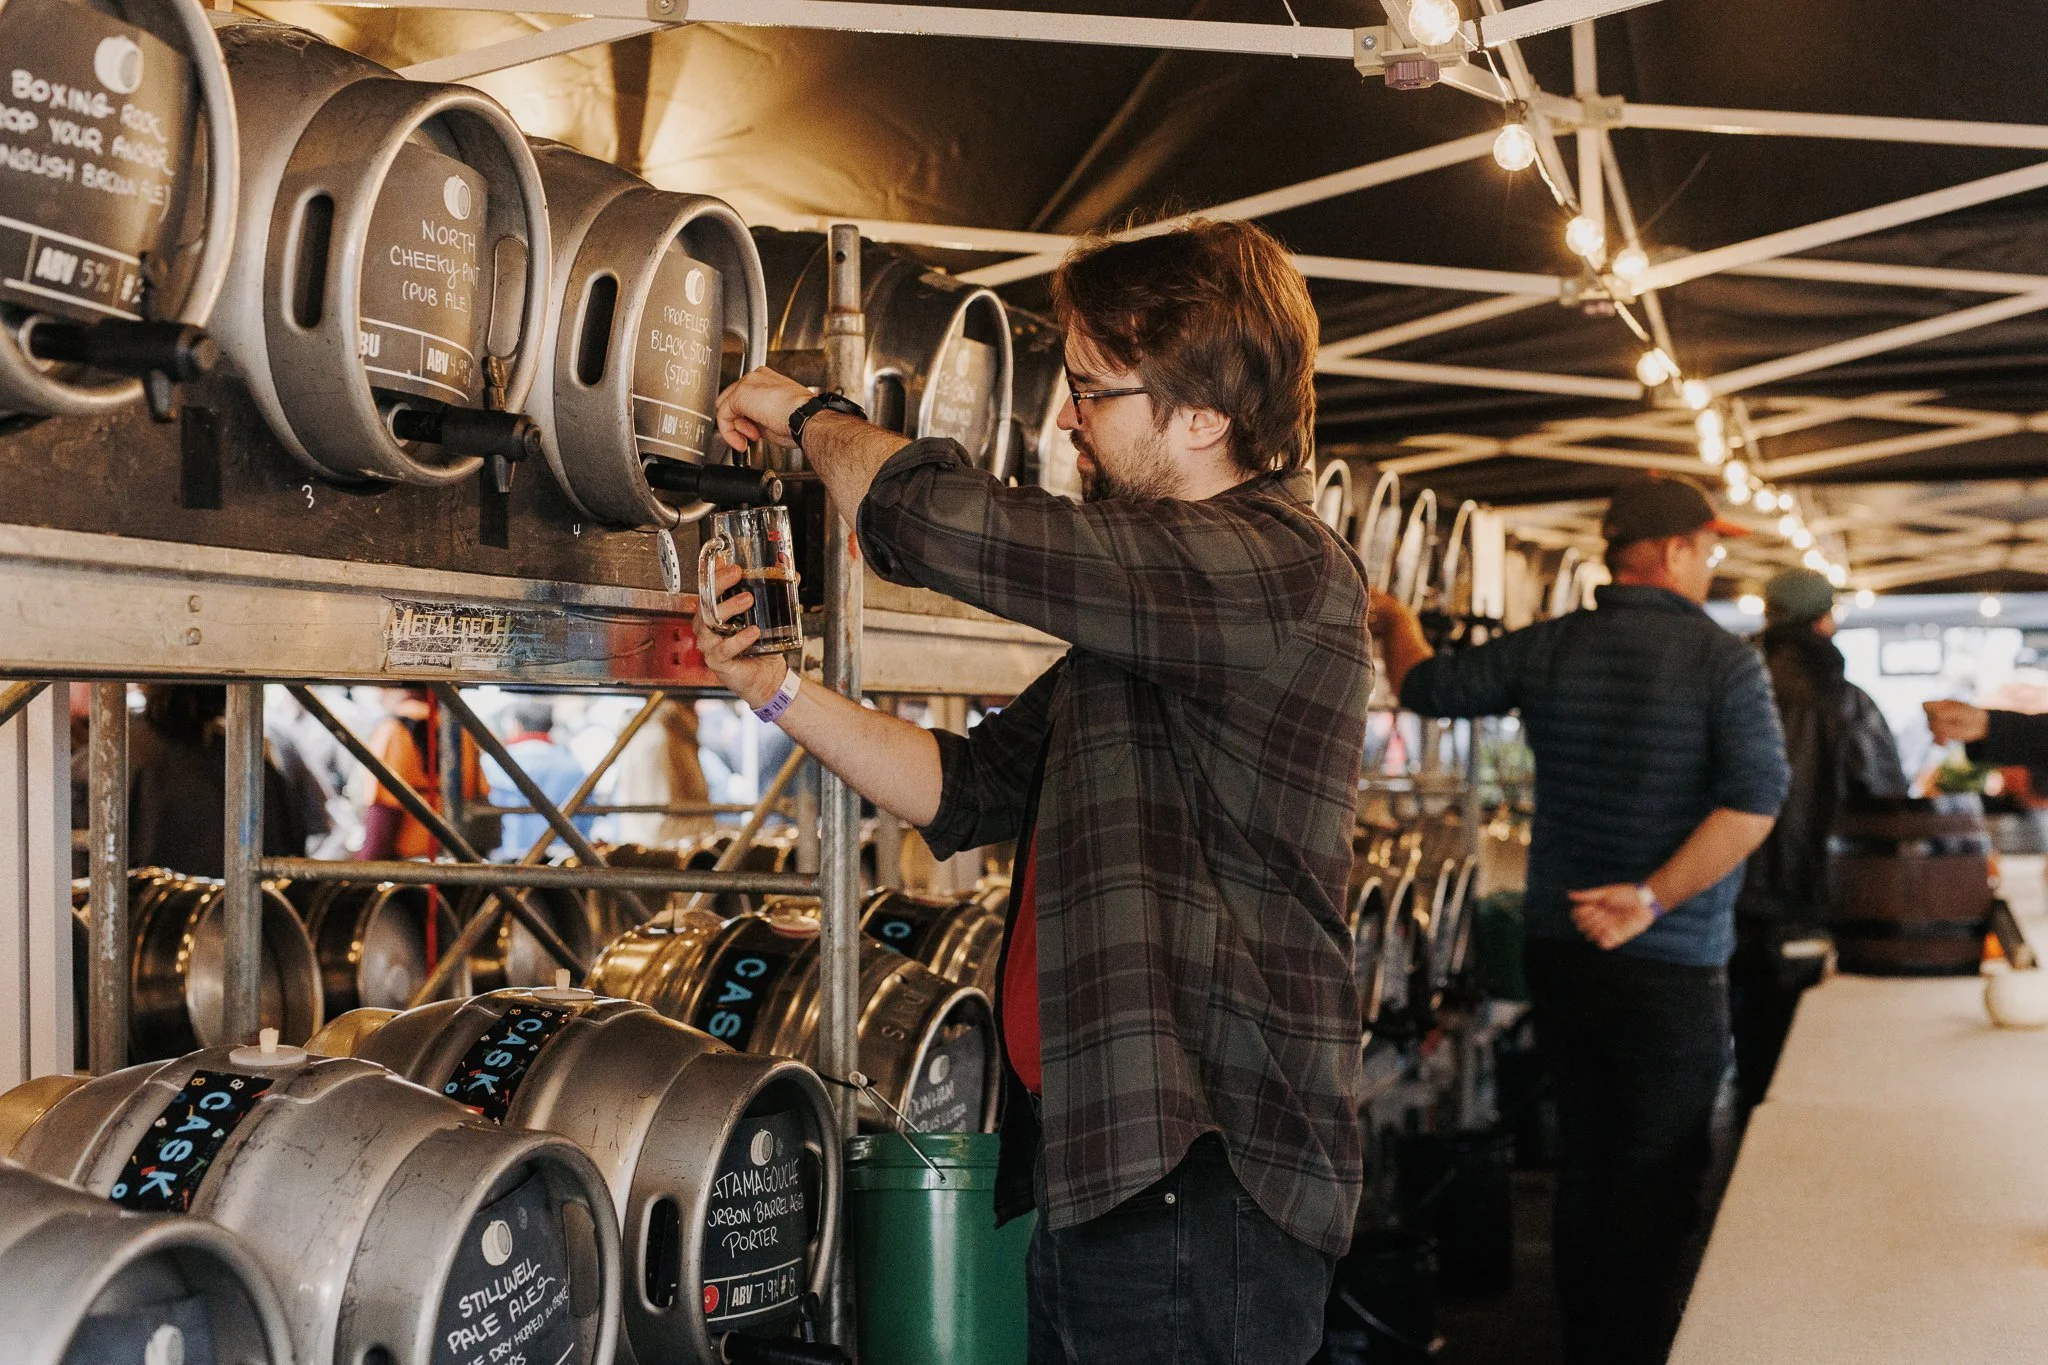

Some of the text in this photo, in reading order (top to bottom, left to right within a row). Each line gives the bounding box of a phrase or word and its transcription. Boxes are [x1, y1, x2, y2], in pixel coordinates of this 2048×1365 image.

[422, 219, 477, 263] NORTH
[402, 280, 438, 307] (PUB
[664, 305, 710, 341] PROPELLER
[651, 329, 688, 360] BLACK
[426, 347, 449, 376] ABV
[662, 413, 678, 436] ABV
[302, 484, 315, 509] 3
[573, 523, 581, 538] 4
[467, 1018, 543, 1096] CASK
[138, 1091, 232, 1199] CASK
[721, 1226, 779, 1259] PORTER
[458, 1257, 541, 1319] STILLWELL
[731, 1284, 753, 1307] ABV
[447, 1312, 501, 1354] PALE
[488, 1337, 512, 1363] DRY
[513, 1313, 544, 1346] HOPPED
